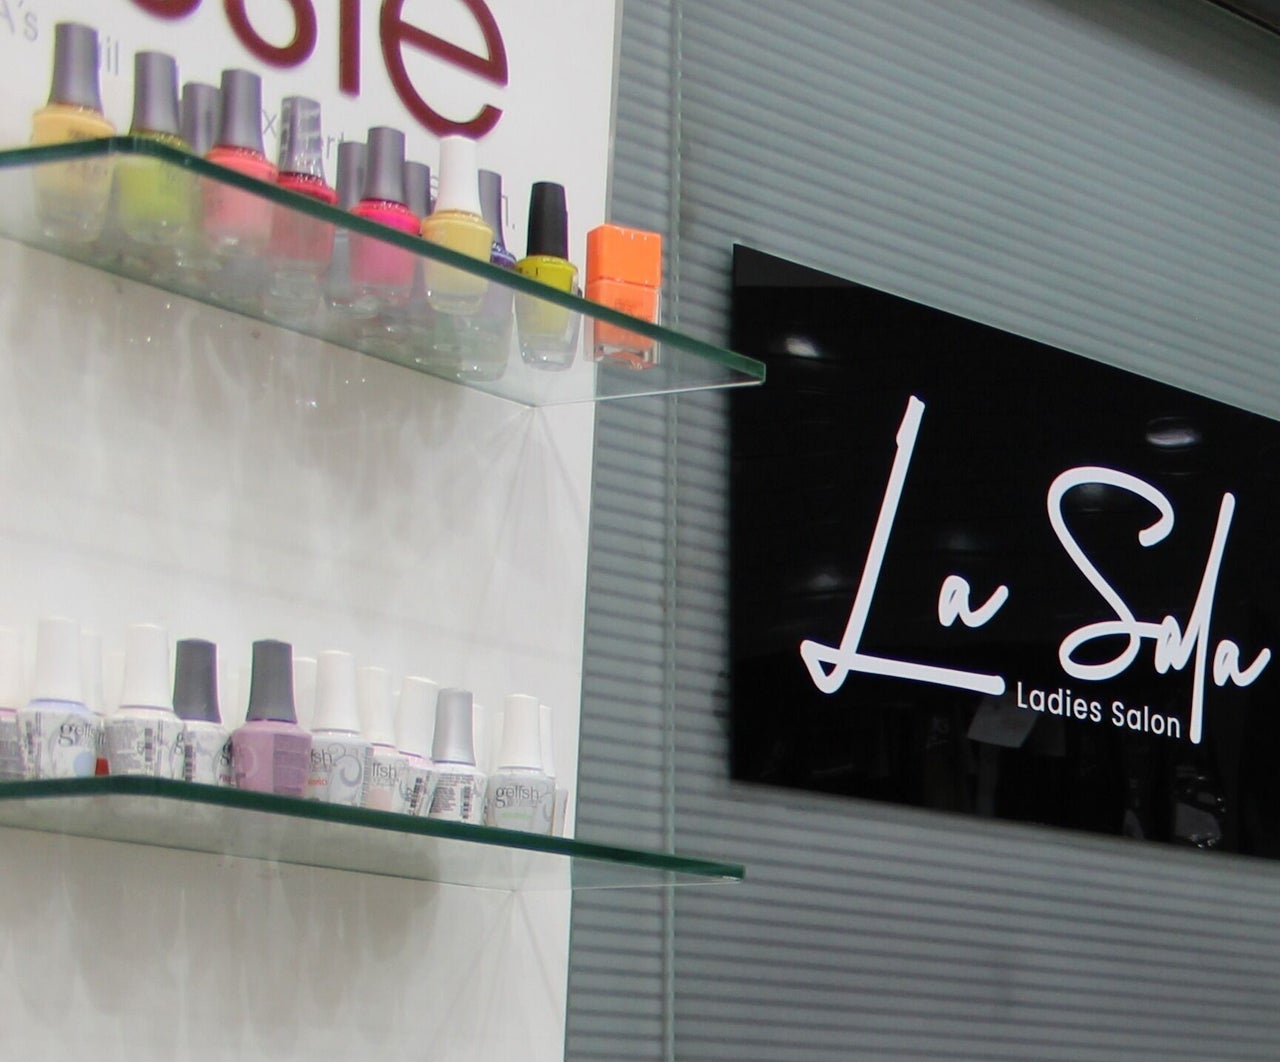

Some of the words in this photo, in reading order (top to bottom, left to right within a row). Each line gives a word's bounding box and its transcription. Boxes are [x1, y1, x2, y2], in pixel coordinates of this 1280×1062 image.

[800, 395, 1009, 694] La
[1017, 681, 1102, 723] Ladies
[1111, 701, 1181, 739] Salon
